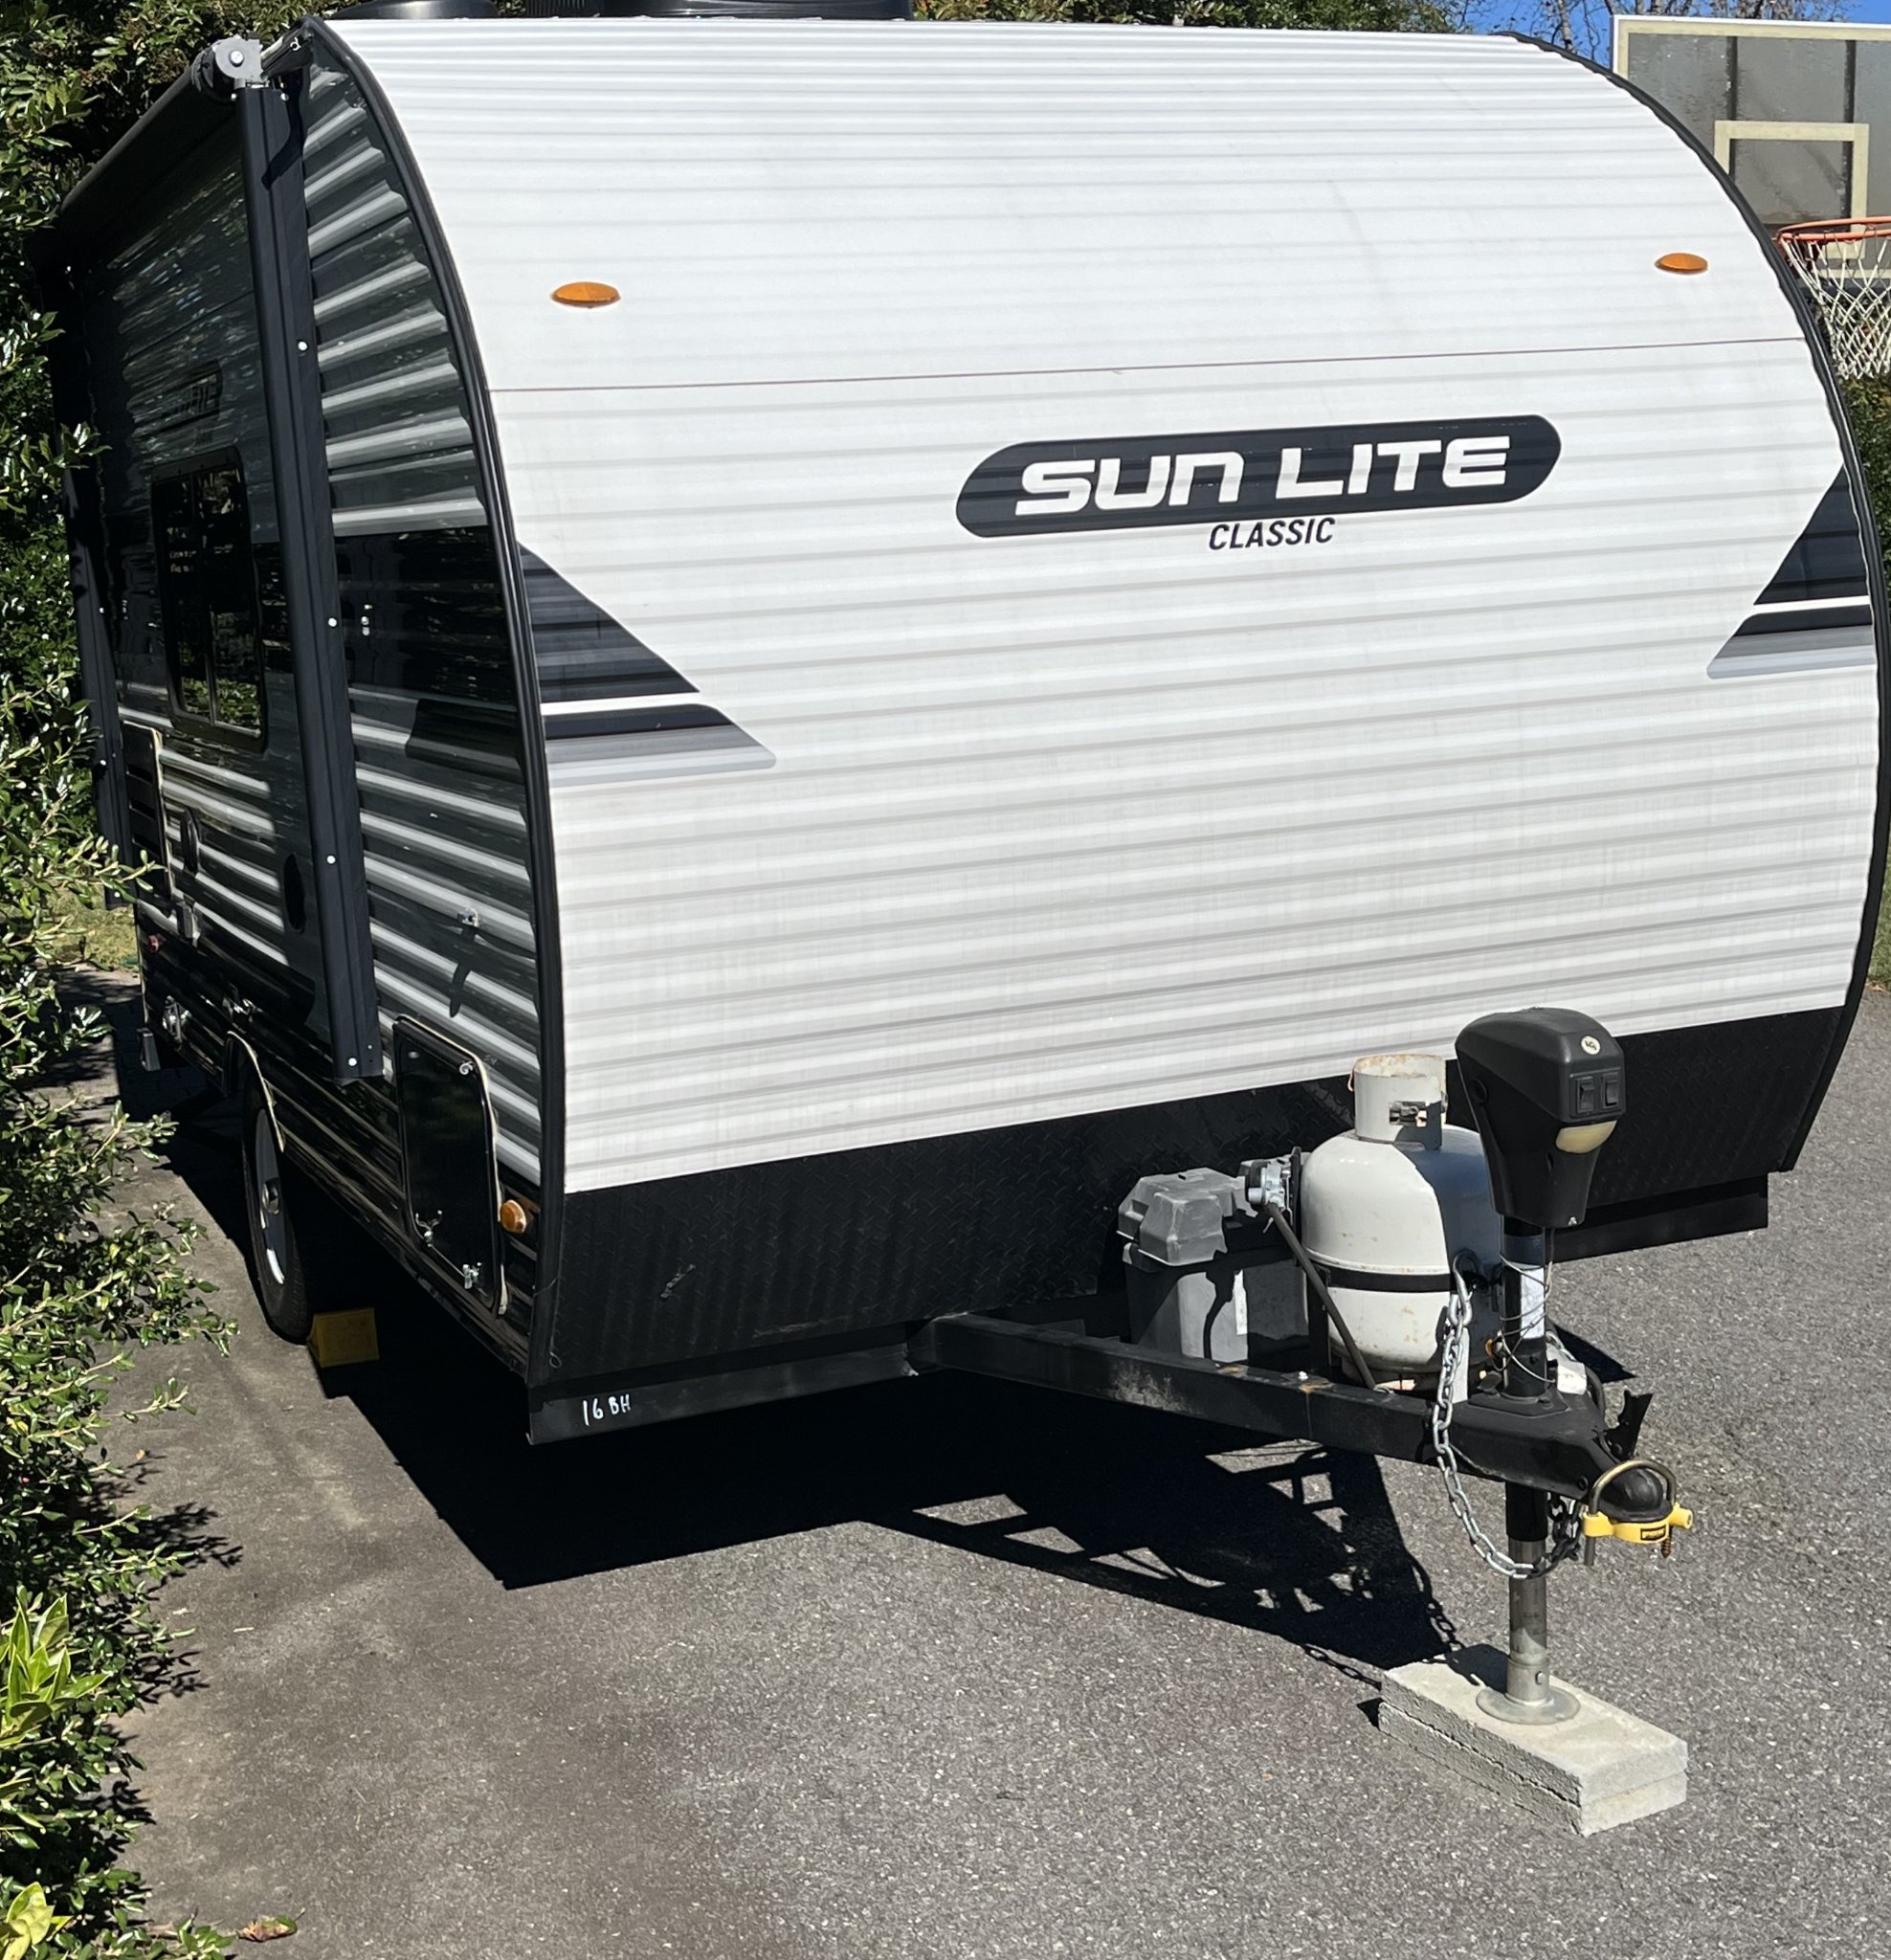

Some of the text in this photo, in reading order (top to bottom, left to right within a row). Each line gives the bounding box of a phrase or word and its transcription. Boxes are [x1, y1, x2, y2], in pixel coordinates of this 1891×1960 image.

[1015, 435, 1511, 516] SUN LITE
[1209, 517, 1336, 551] CLASSIC
[583, 1393, 632, 1426] 16 BH
